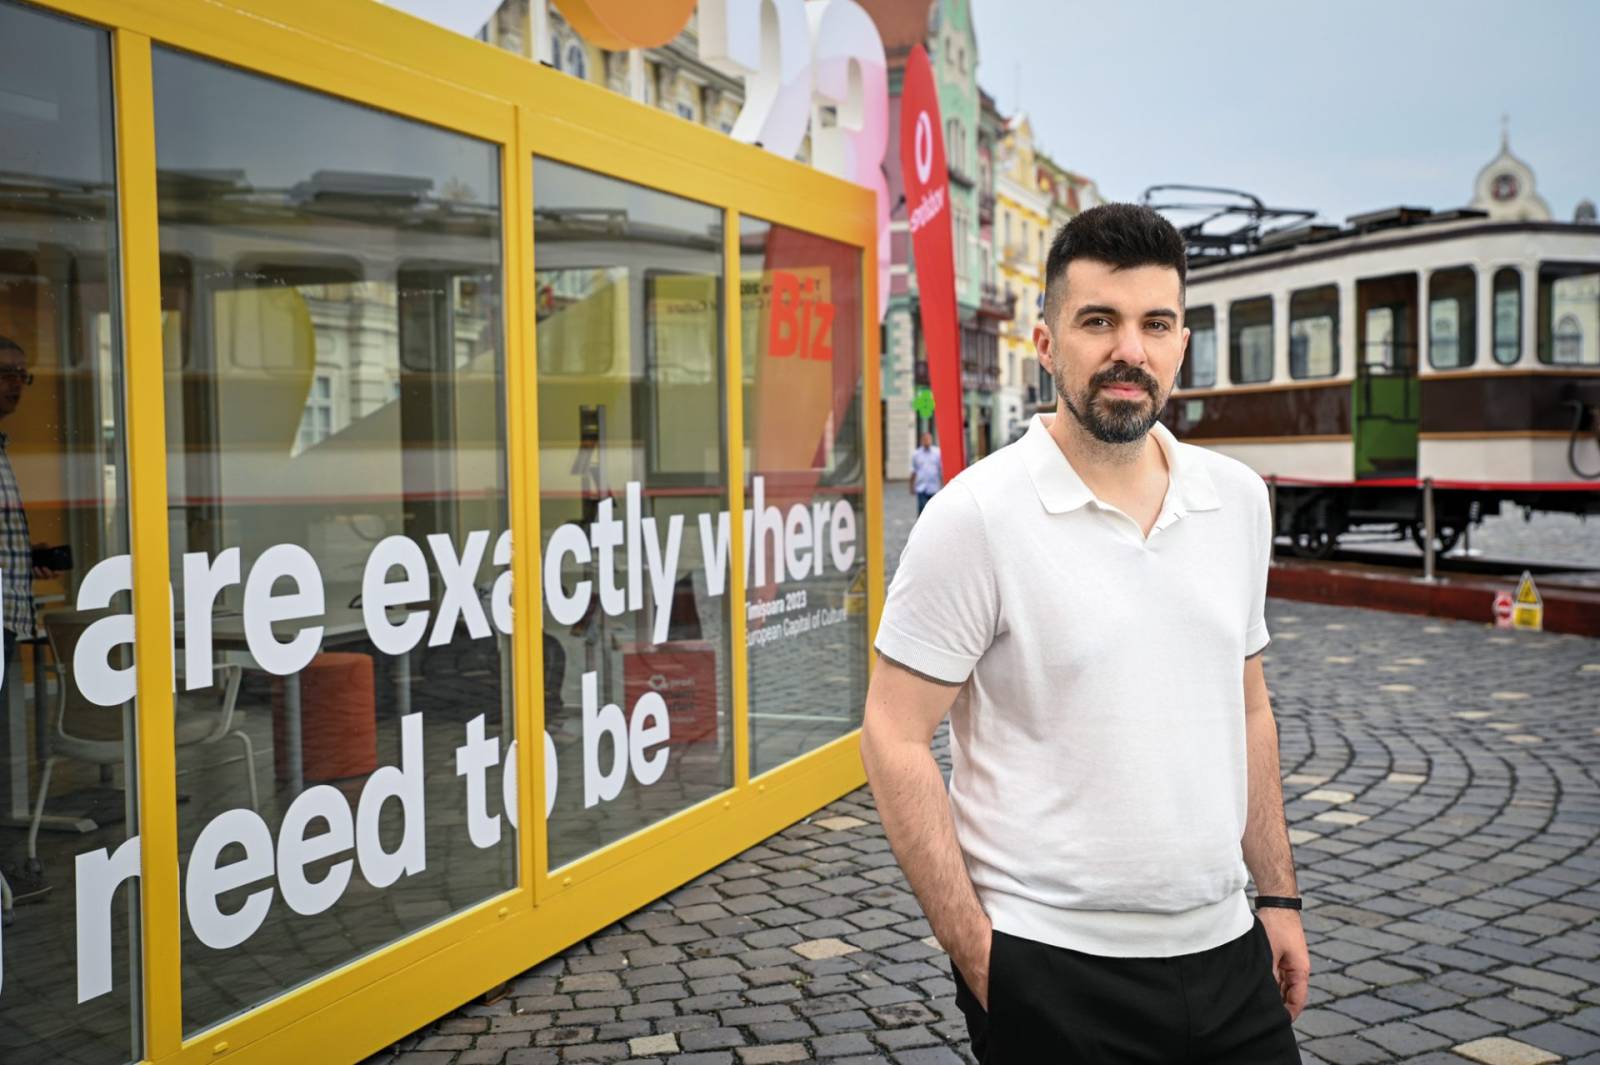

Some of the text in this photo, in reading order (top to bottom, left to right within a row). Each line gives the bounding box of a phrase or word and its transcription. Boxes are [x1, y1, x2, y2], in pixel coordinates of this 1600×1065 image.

[768, 271, 836, 362] Biz
[73, 542, 326, 707] are
[698, 475, 856, 598] where
[783, 612, 811, 637] Capital
[812, 608, 820, 629] of
[786, 590, 807, 611] 2023
[75, 712, 426, 1004] need
[456, 713, 558, 850] to
[582, 671, 670, 808] be
